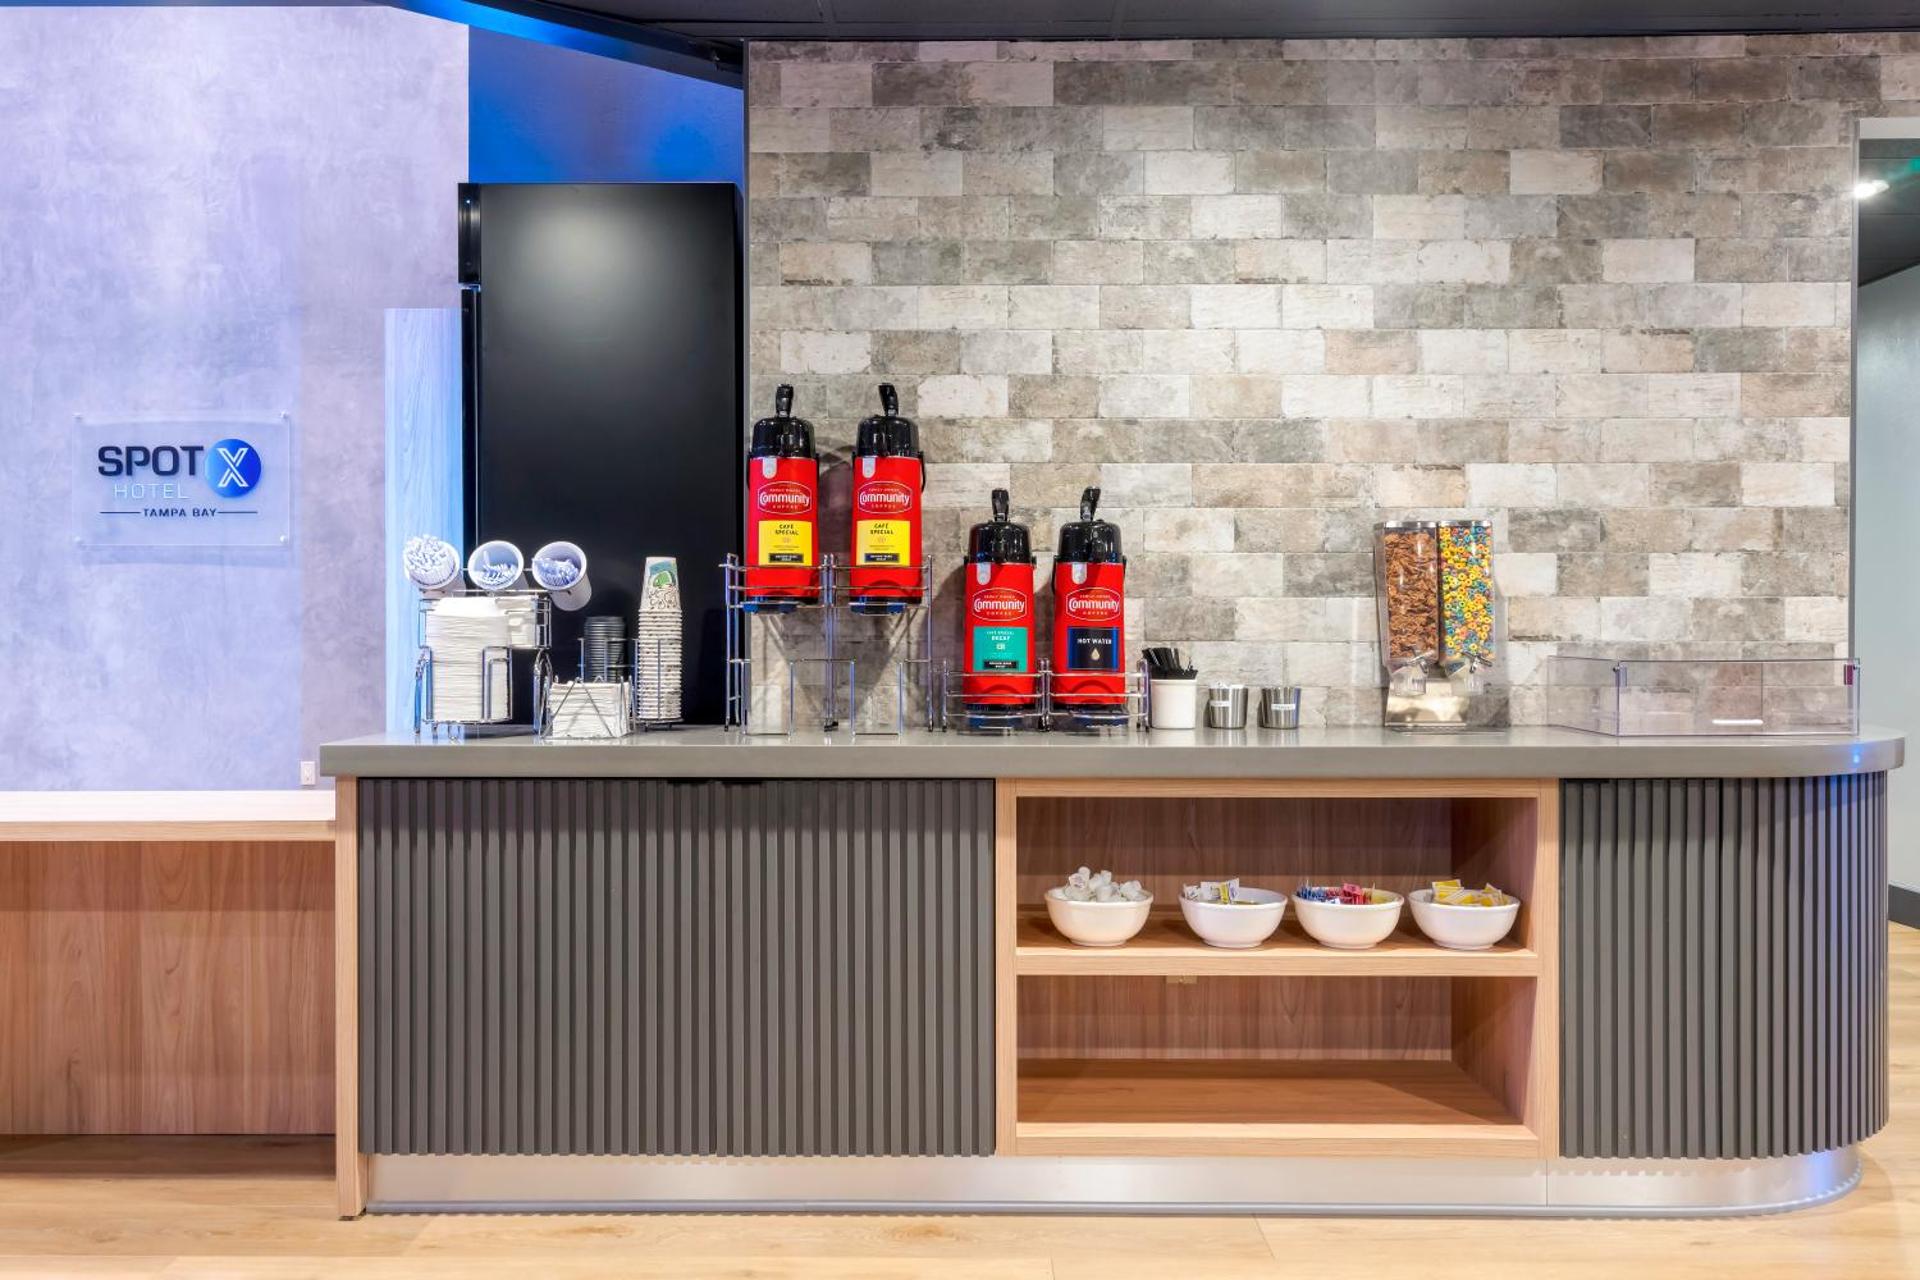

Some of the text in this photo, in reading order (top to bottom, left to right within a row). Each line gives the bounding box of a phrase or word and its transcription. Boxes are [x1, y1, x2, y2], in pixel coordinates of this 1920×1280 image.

[98, 445, 249, 488] SPOT X
[113, 483, 190, 500] HOTEL
[759, 491, 810, 507] Community
[859, 491, 910, 507] Community
[143, 508, 218, 518] TAMPA BAY
[973, 598, 1025, 613] Community
[1068, 597, 1119, 613] Community
